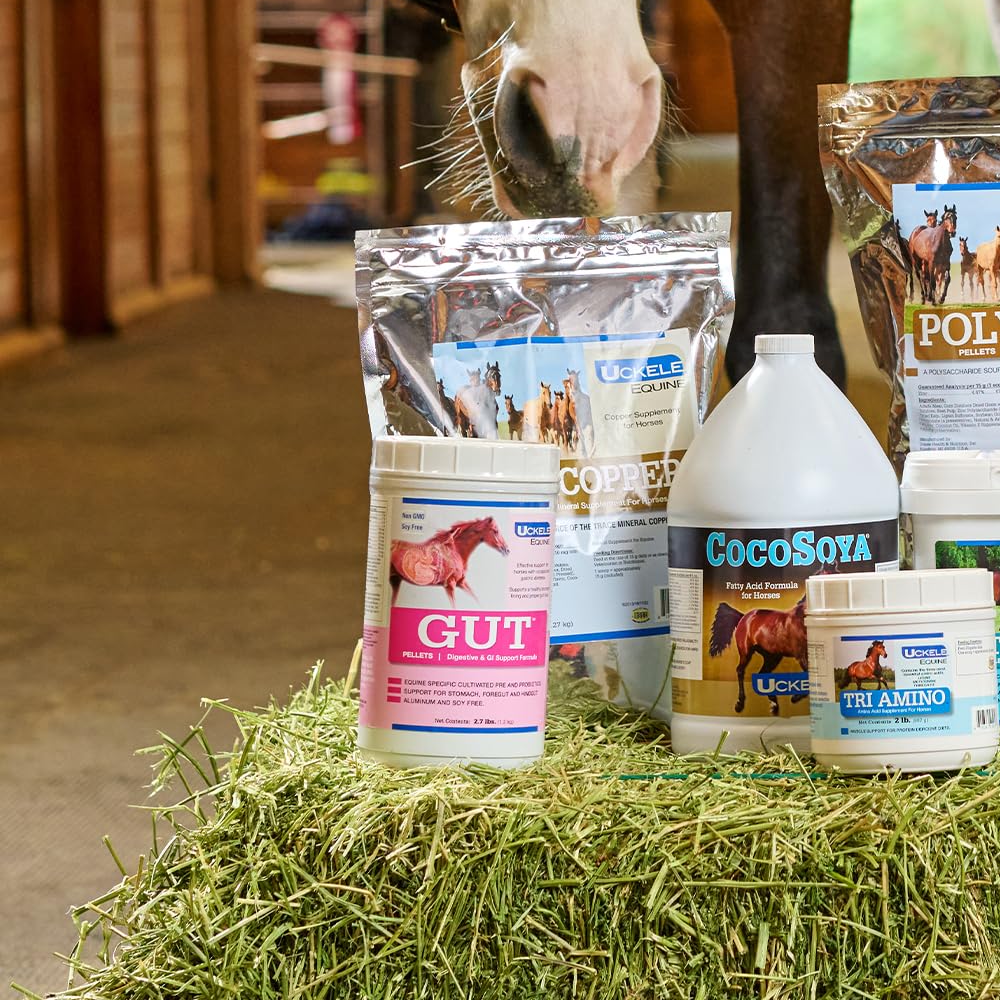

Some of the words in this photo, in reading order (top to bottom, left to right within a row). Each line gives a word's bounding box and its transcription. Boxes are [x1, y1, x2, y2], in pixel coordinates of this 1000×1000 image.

[959, 348, 996, 356] PELLETS
[600, 361, 684, 380] UCKELE
[929, 368, 982, 376] POLYSACCHARIDE
[636, 420, 663, 428] Horses
[618, 518, 647, 528] MINERAL
[650, 517, 668, 526] COPP
[726, 581, 744, 590] Fatty
[745, 582, 763, 590] Acid
[764, 581, 798, 590] Formula
[418, 614, 532, 650] GUT
[402, 651, 434, 659] PELLETS
[757, 679, 809, 693] UCKE
[843, 692, 873, 708] TRI
[878, 690, 946, 707] AMINO
